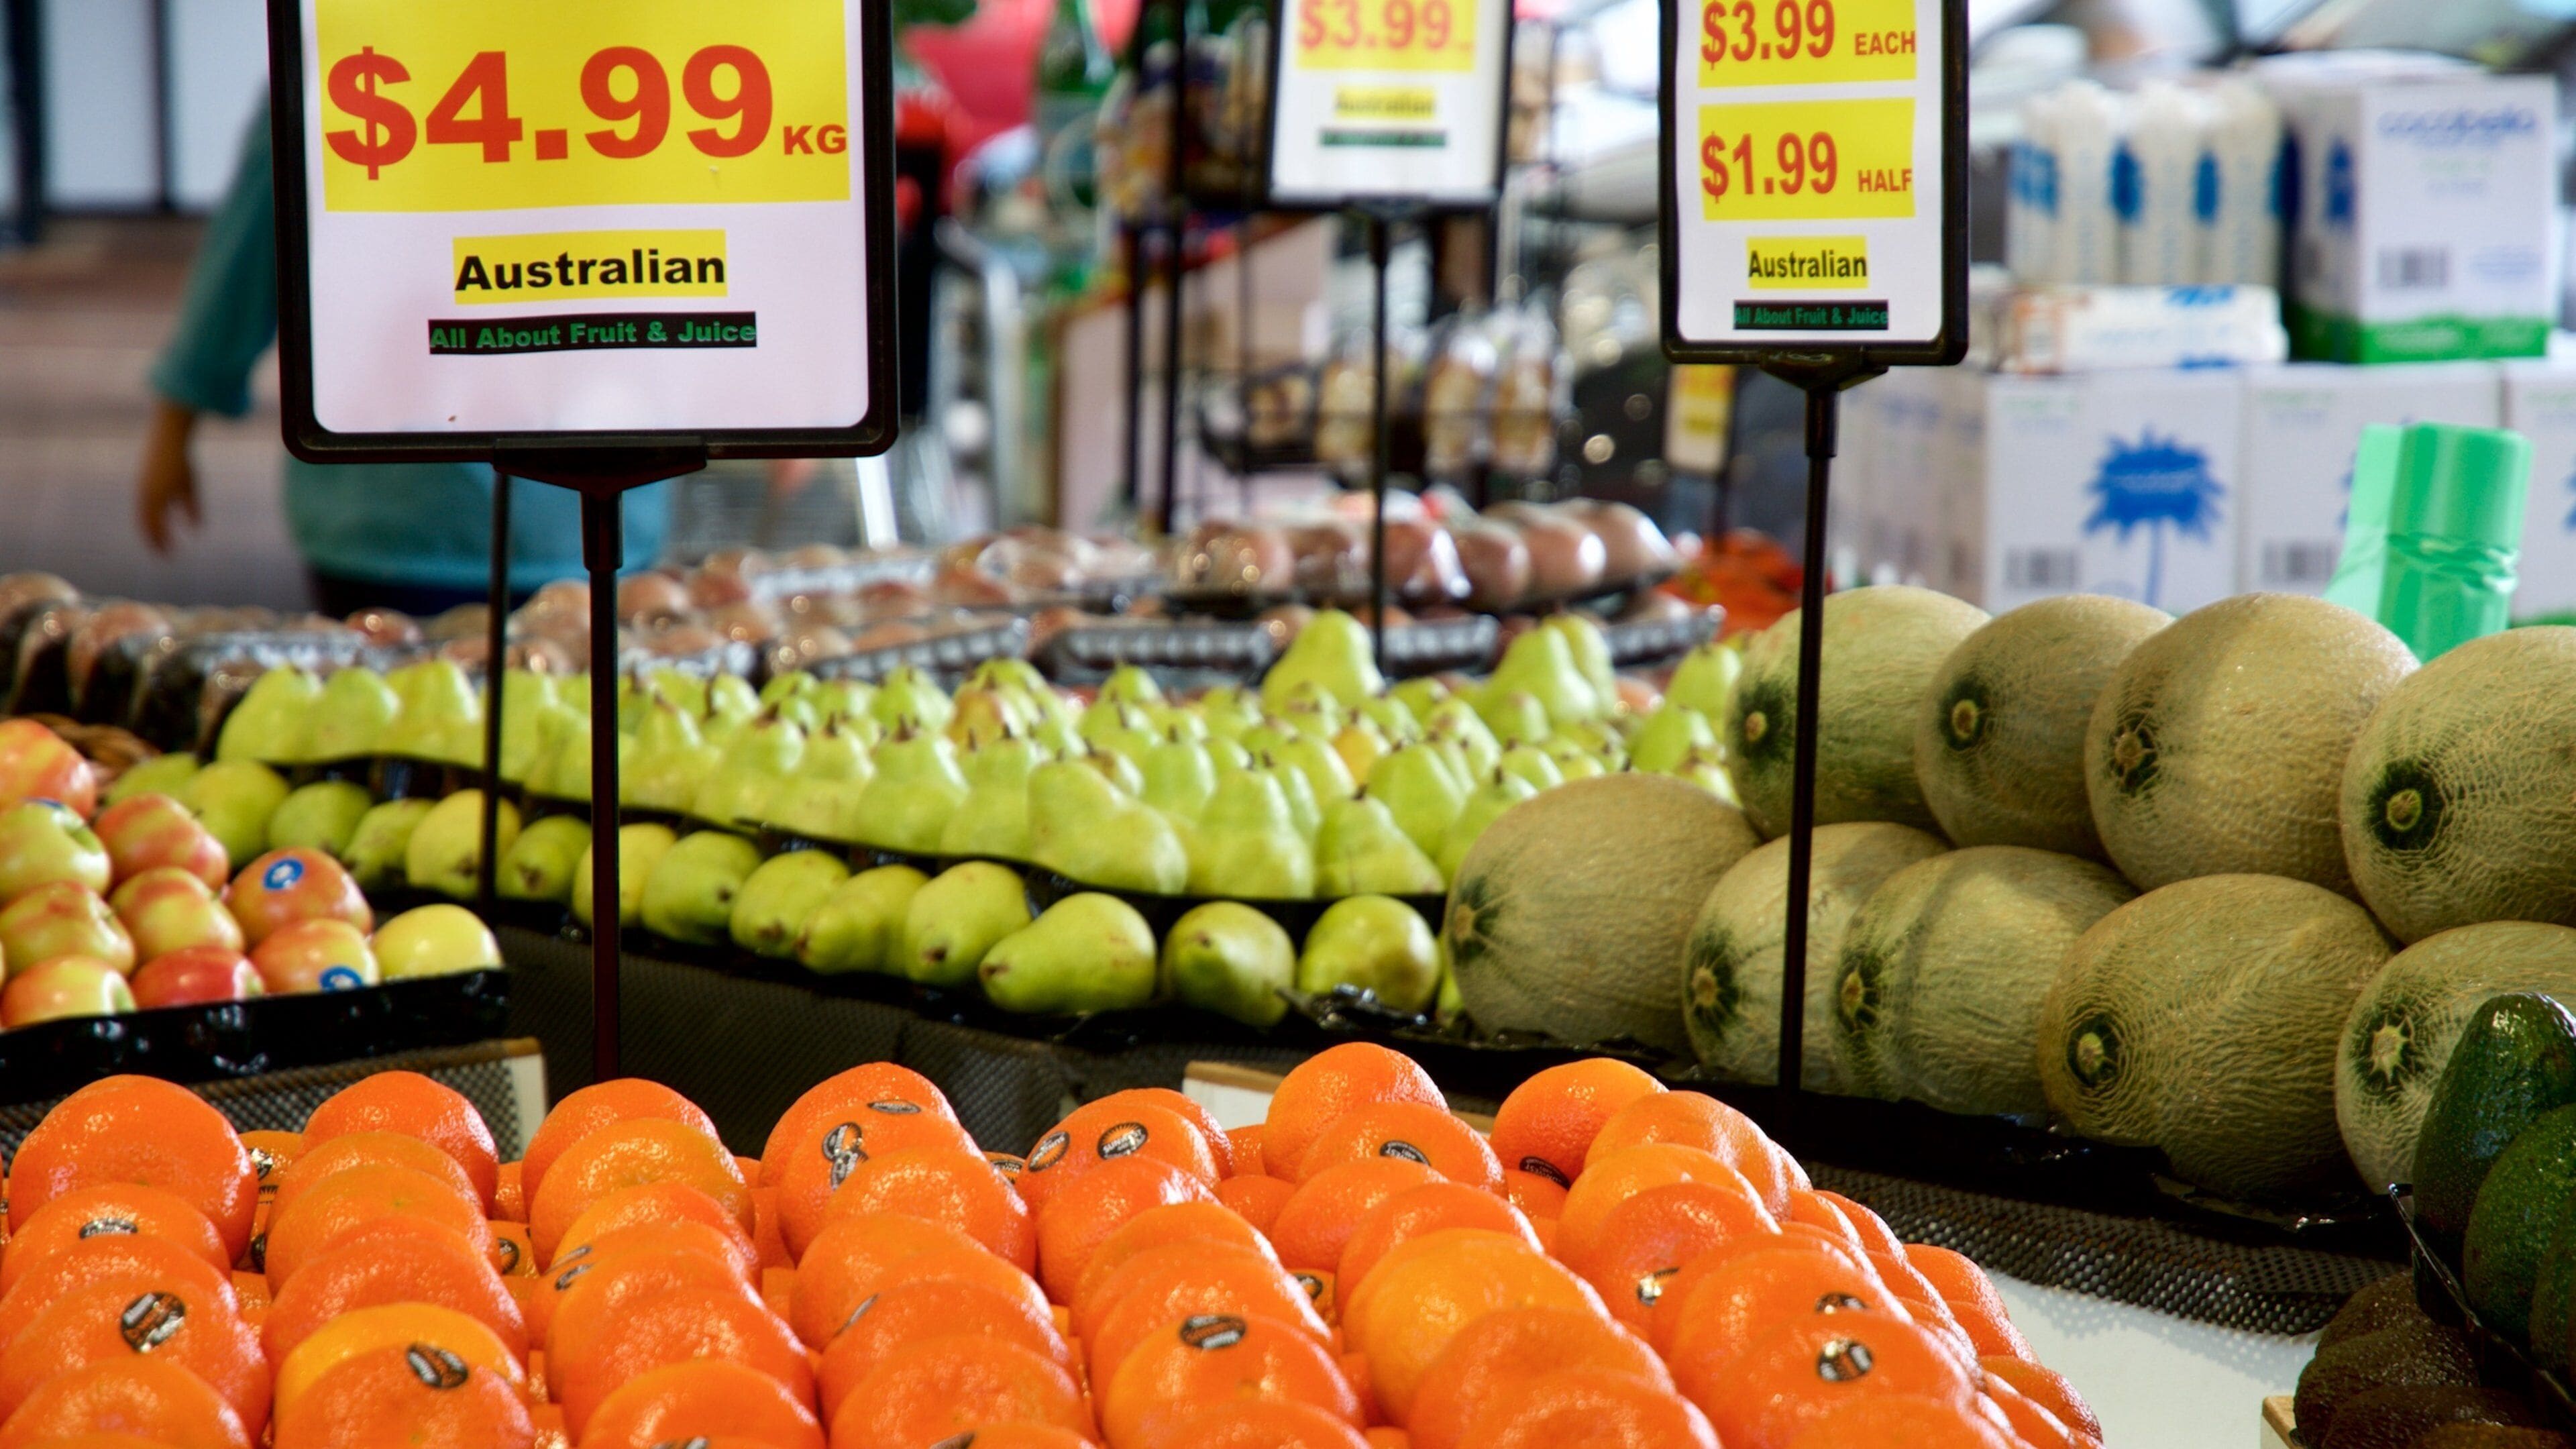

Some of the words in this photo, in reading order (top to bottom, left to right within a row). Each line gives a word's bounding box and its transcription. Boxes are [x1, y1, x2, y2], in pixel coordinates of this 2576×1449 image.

[1701, 0, 1835, 70] $3.99
[1854, 31, 1916, 56] EACH
[325, 46, 773, 180] $4.99
[784, 124, 847, 155] KG
[1701, 131, 1838, 203] $1.99
[1858, 168, 1913, 193] HALF
[454, 248, 726, 290] Australian
[1748, 249, 1868, 278] Australian
[430, 327, 466, 348] All
[476, 323, 561, 348] About
[570, 321, 637, 343] Fruit
[647, 320, 669, 342] &
[677, 321, 756, 342] Juice
[1735, 307, 1750, 325] All
[1754, 308, 1792, 325] About
[1795, 308, 1827, 325] Fruit
[1831, 307, 1843, 324] &
[1847, 308, 1888, 324] Juice
